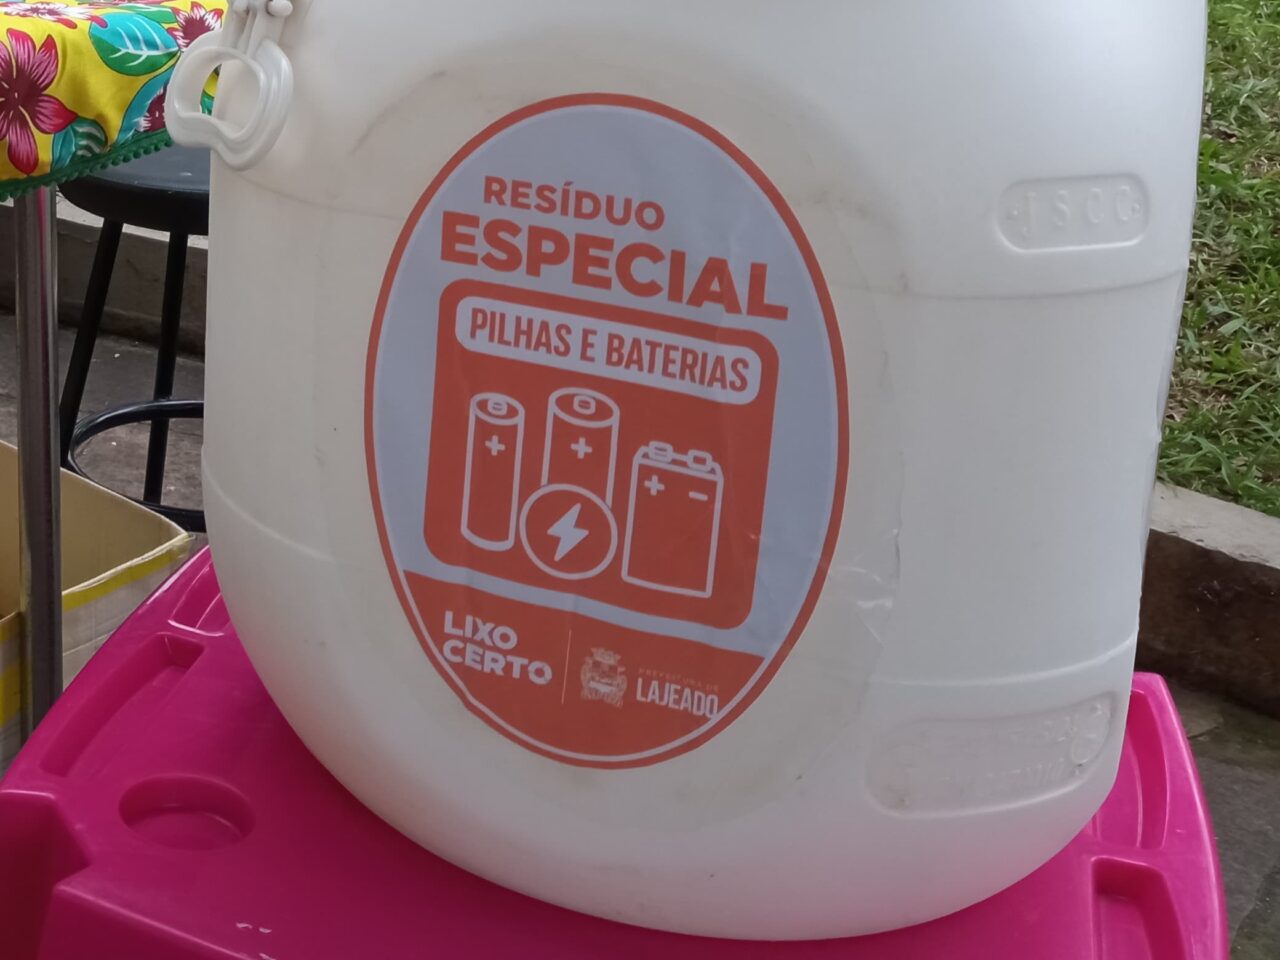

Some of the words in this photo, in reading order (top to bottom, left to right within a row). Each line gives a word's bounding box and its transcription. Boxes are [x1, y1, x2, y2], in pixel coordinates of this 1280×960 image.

[483, 175, 665, 231] RESÍDUO
[439, 210, 789, 321] ESPECIAL
[469, 307, 572, 358] PILHAS
[579, 328, 595, 363] E
[606, 334, 749, 393] BATERIAS
[443, 610, 518, 650] LIXO
[442, 639, 553, 686] CERTO
[636, 677, 720, 718] LAJEADO
